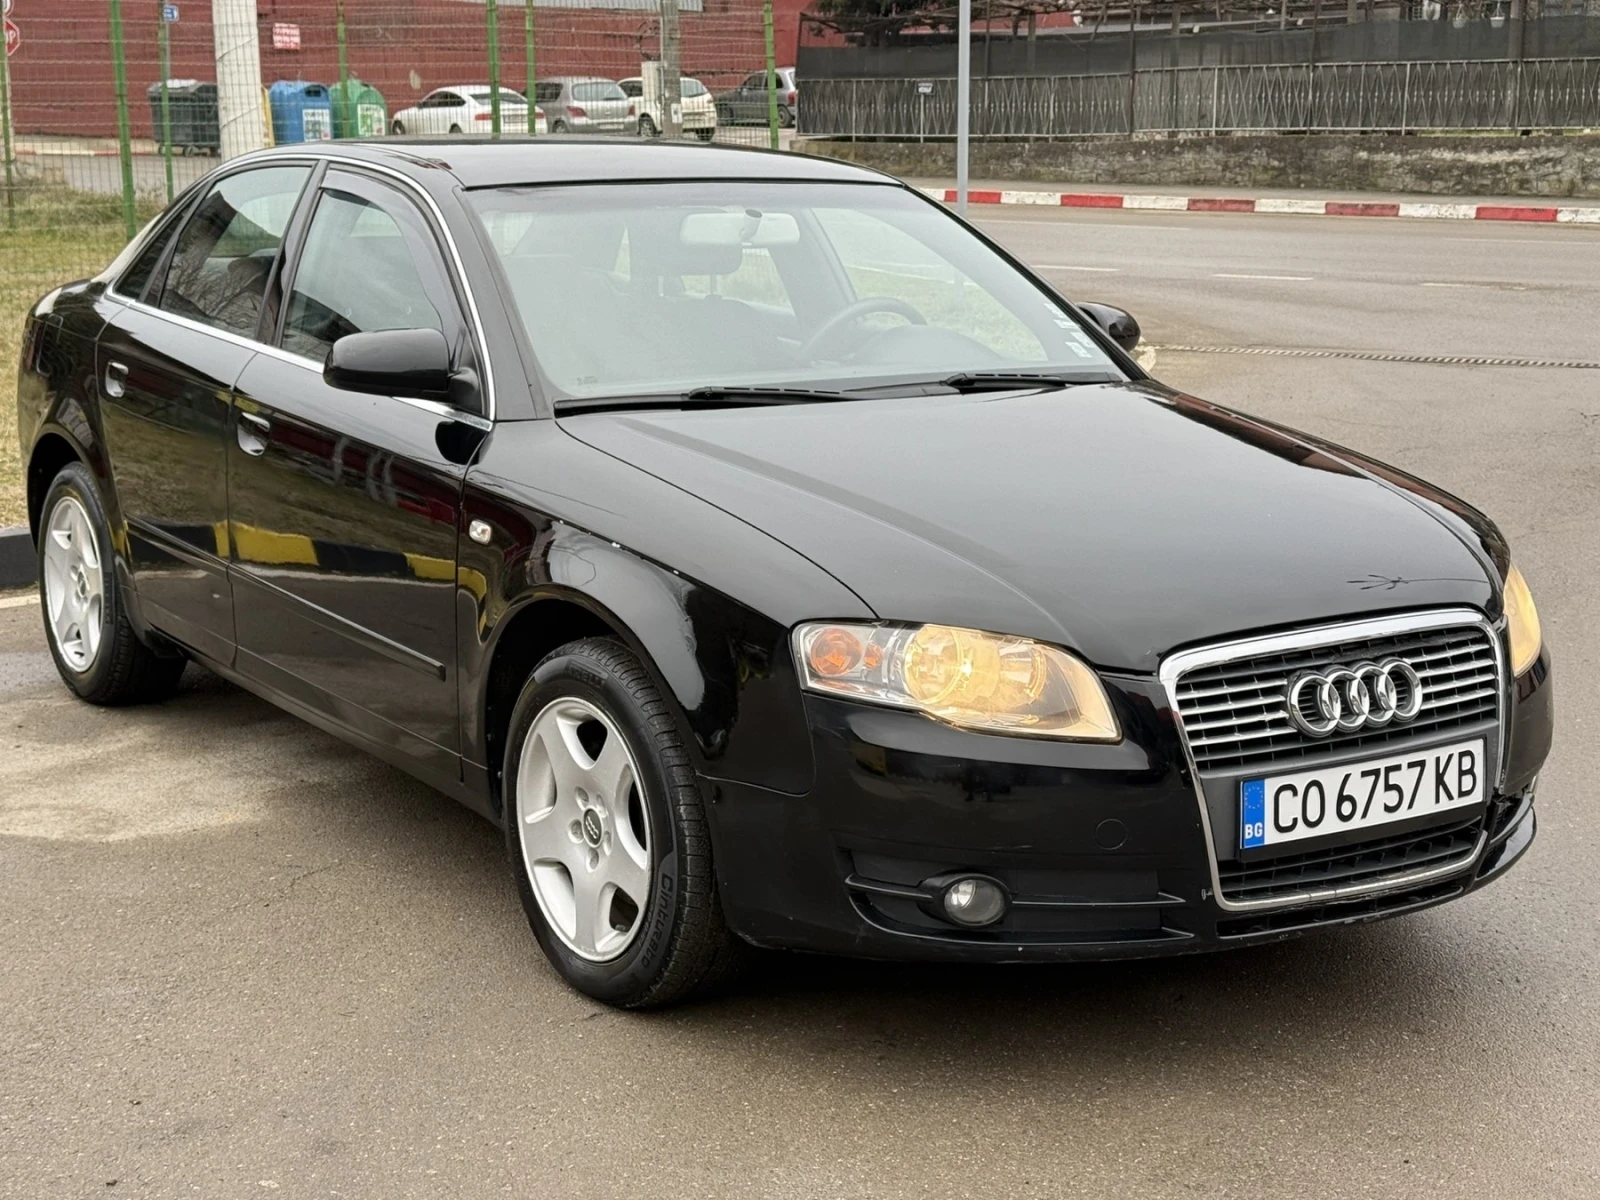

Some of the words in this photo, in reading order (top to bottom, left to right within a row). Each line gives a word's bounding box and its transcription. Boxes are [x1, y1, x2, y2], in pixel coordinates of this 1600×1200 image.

[1273, 779, 1326, 834] CO
[1336, 759, 1426, 823] 6757
[1434, 749, 1478, 804] KB
[1244, 822, 1263, 839] BG
